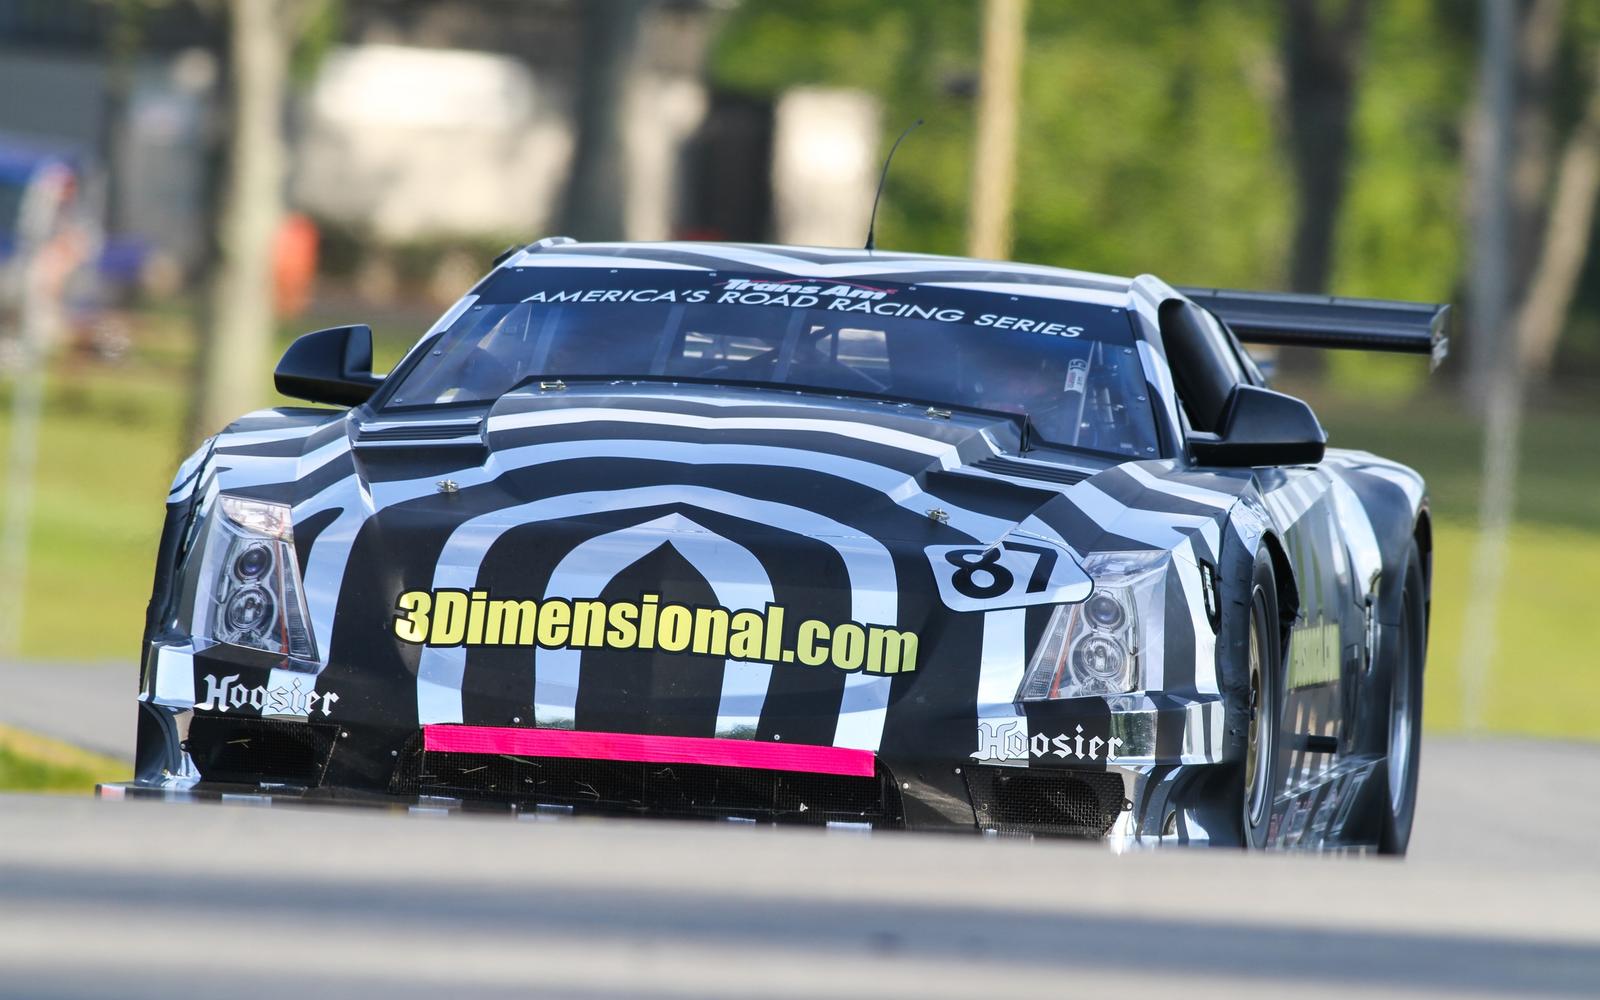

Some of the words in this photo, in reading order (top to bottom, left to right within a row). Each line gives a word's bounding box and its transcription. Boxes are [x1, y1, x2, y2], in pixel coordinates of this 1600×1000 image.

[520, 289, 710, 304] AMERICA'S
[717, 291, 819, 308] ROAD
[827, 297, 966, 322] RACING
[973, 313, 1084, 338] SERIES
[723, 279, 822, 295] Trans
[827, 284, 888, 302] Am
[944, 541, 1059, 600] 87
[394, 590, 919, 674] 3Dimensional.com
[192, 673, 340, 717] Hoosier
[969, 720, 1124, 763] Hoosier
